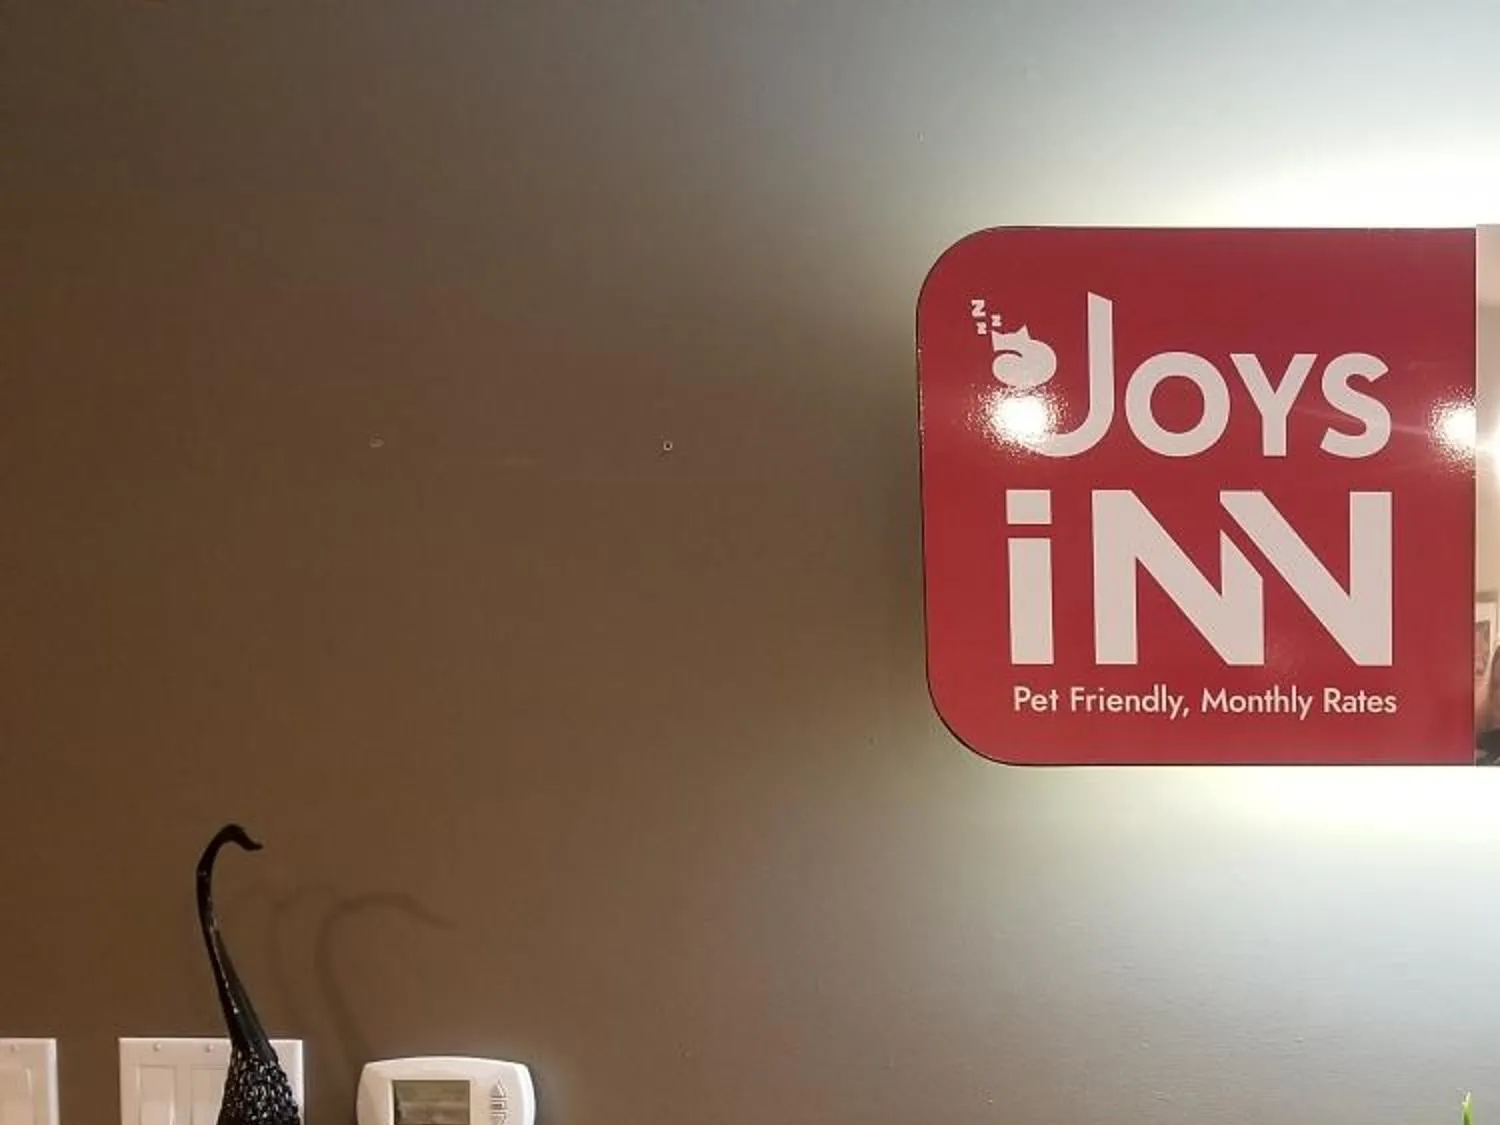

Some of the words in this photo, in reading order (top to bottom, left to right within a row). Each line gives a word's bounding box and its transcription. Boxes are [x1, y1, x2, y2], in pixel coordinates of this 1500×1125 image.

[995, 291, 1393, 458] JOYS
[1013, 685, 1059, 712] Pet
[1070, 683, 1190, 720] Friendly,
[1201, 684, 1313, 721] Monthly
[1323, 687, 1397, 713] Rates
